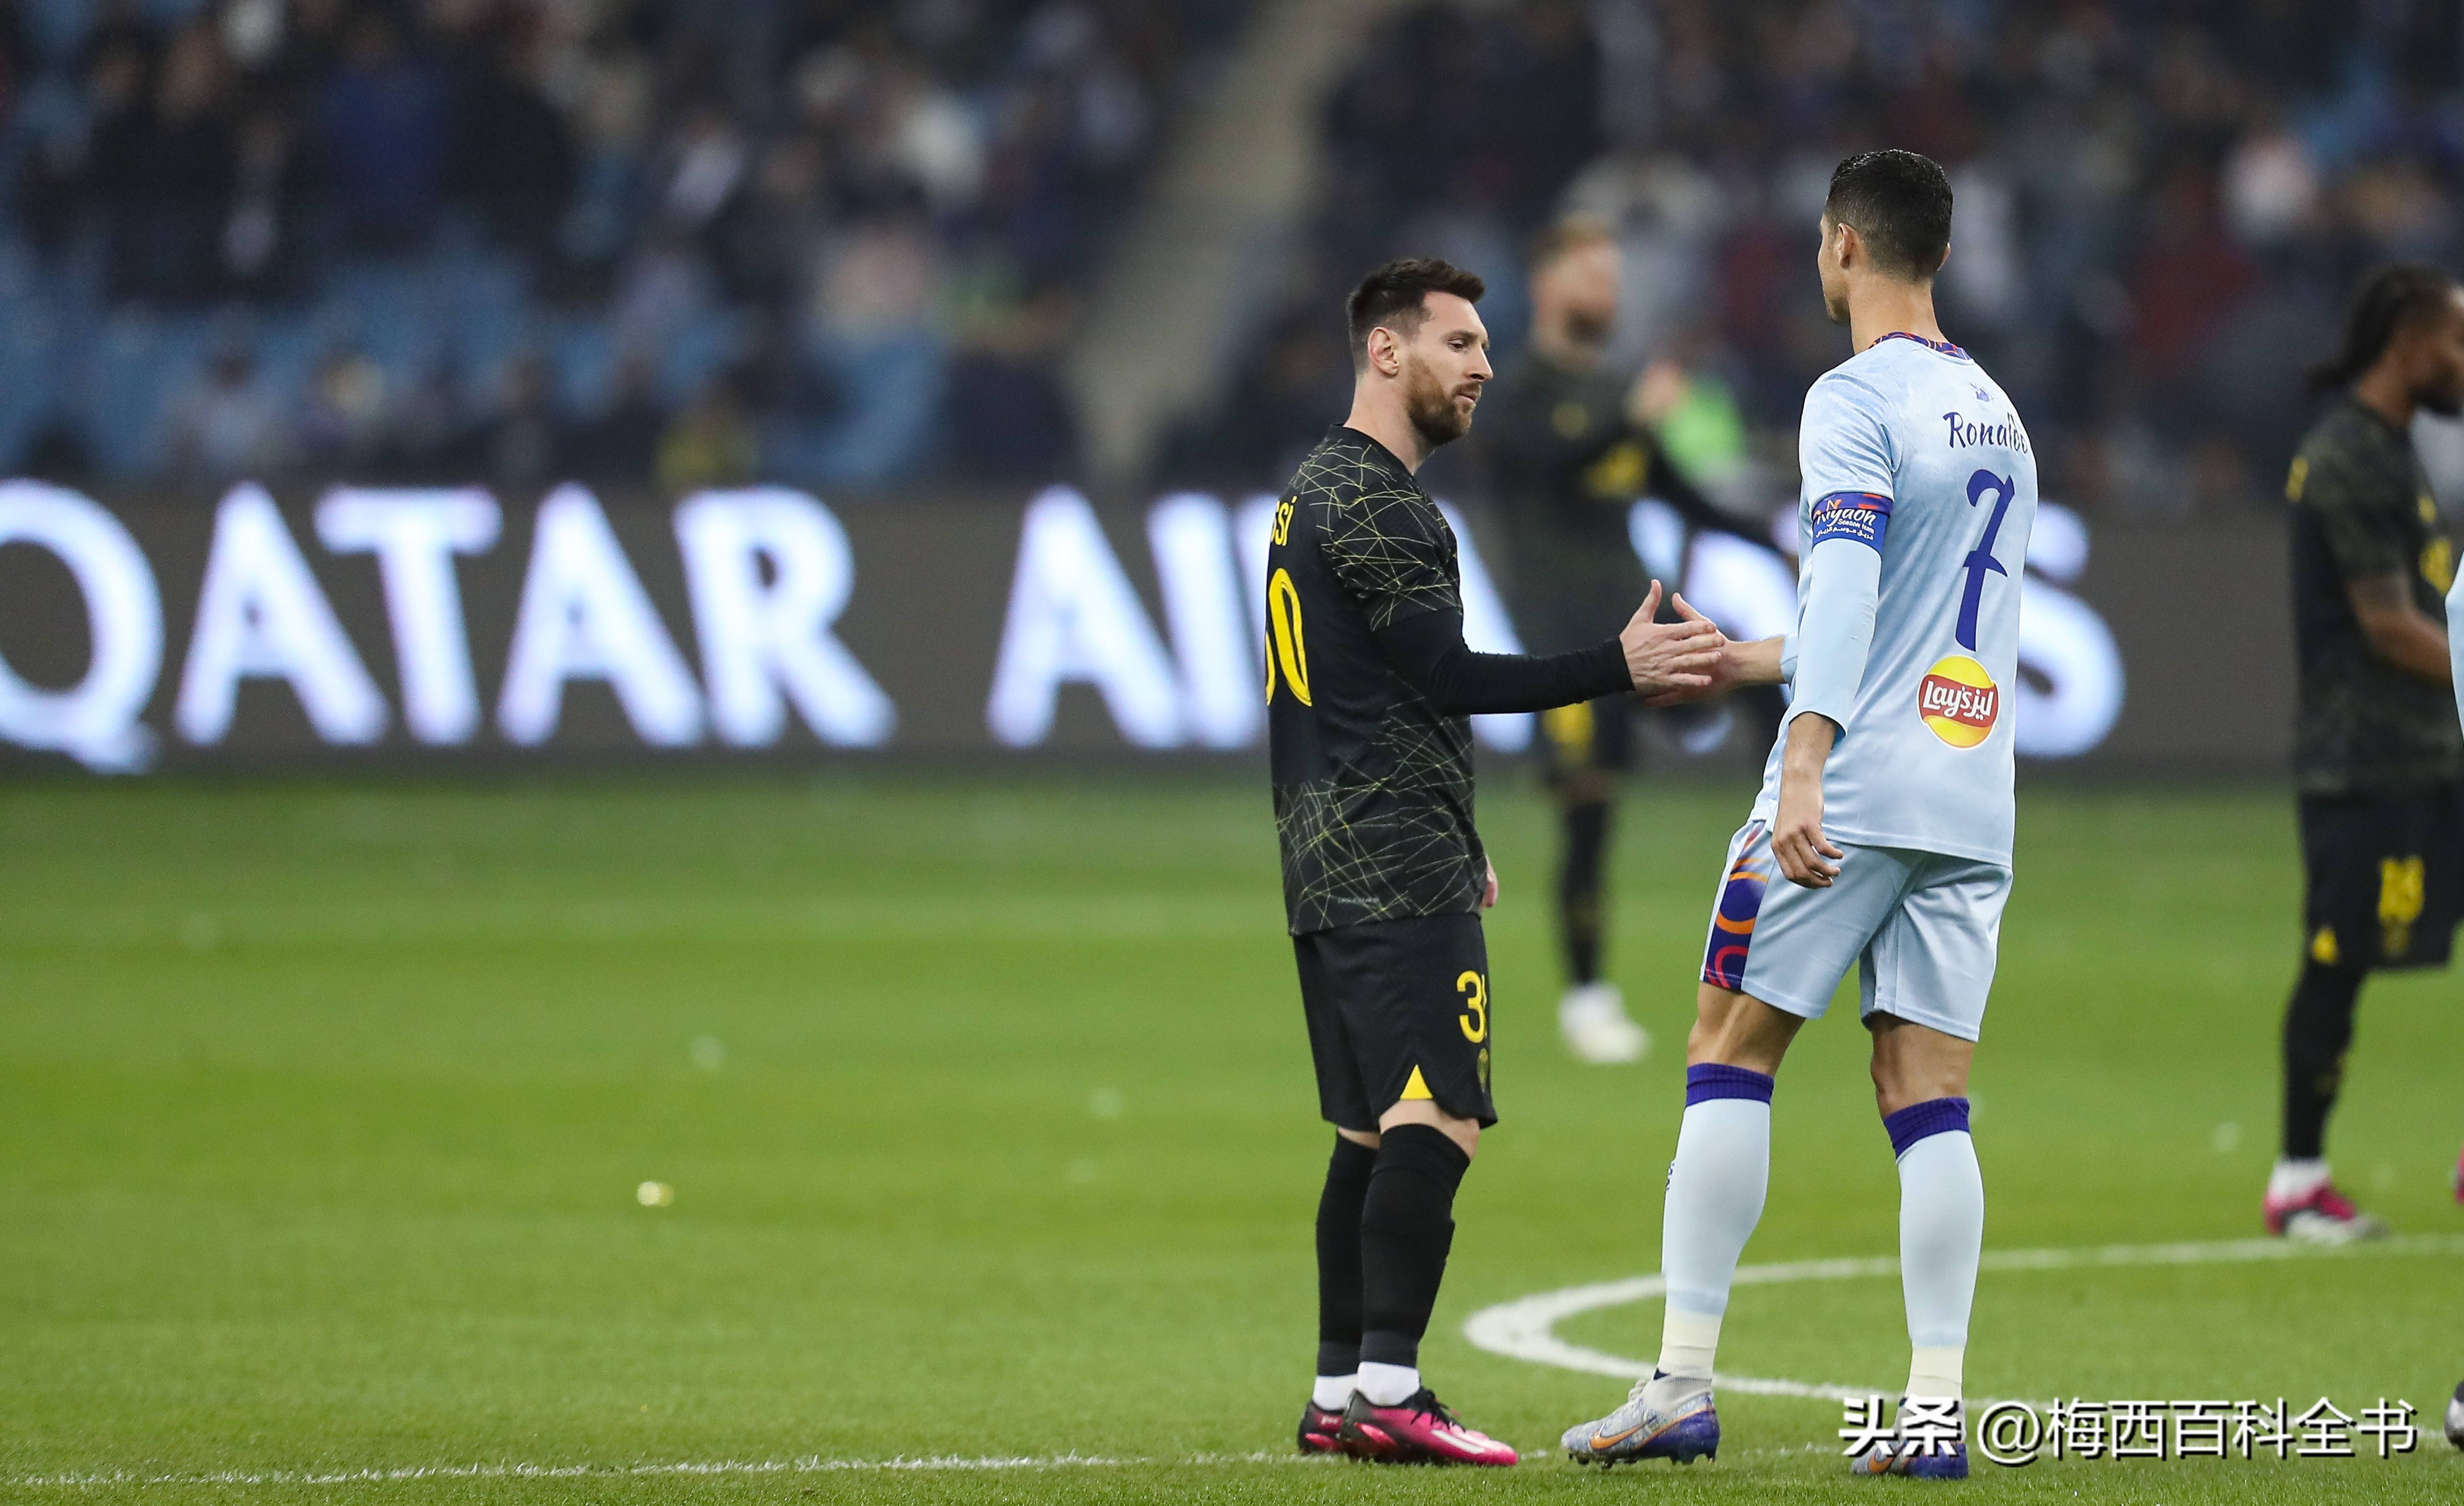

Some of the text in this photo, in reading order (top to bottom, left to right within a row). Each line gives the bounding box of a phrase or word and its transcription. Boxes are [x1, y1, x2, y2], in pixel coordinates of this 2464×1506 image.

[1942, 412, 2028, 454] Ronaldo
[1838, 518, 1861, 528] Season
[1956, 469, 2015, 652] 7
[0, 479, 899, 772] QATAR
[1266, 568, 1312, 707] 0
[1922, 680, 1972, 718] Lay's
[1457, 970, 1487, 1043] 3
